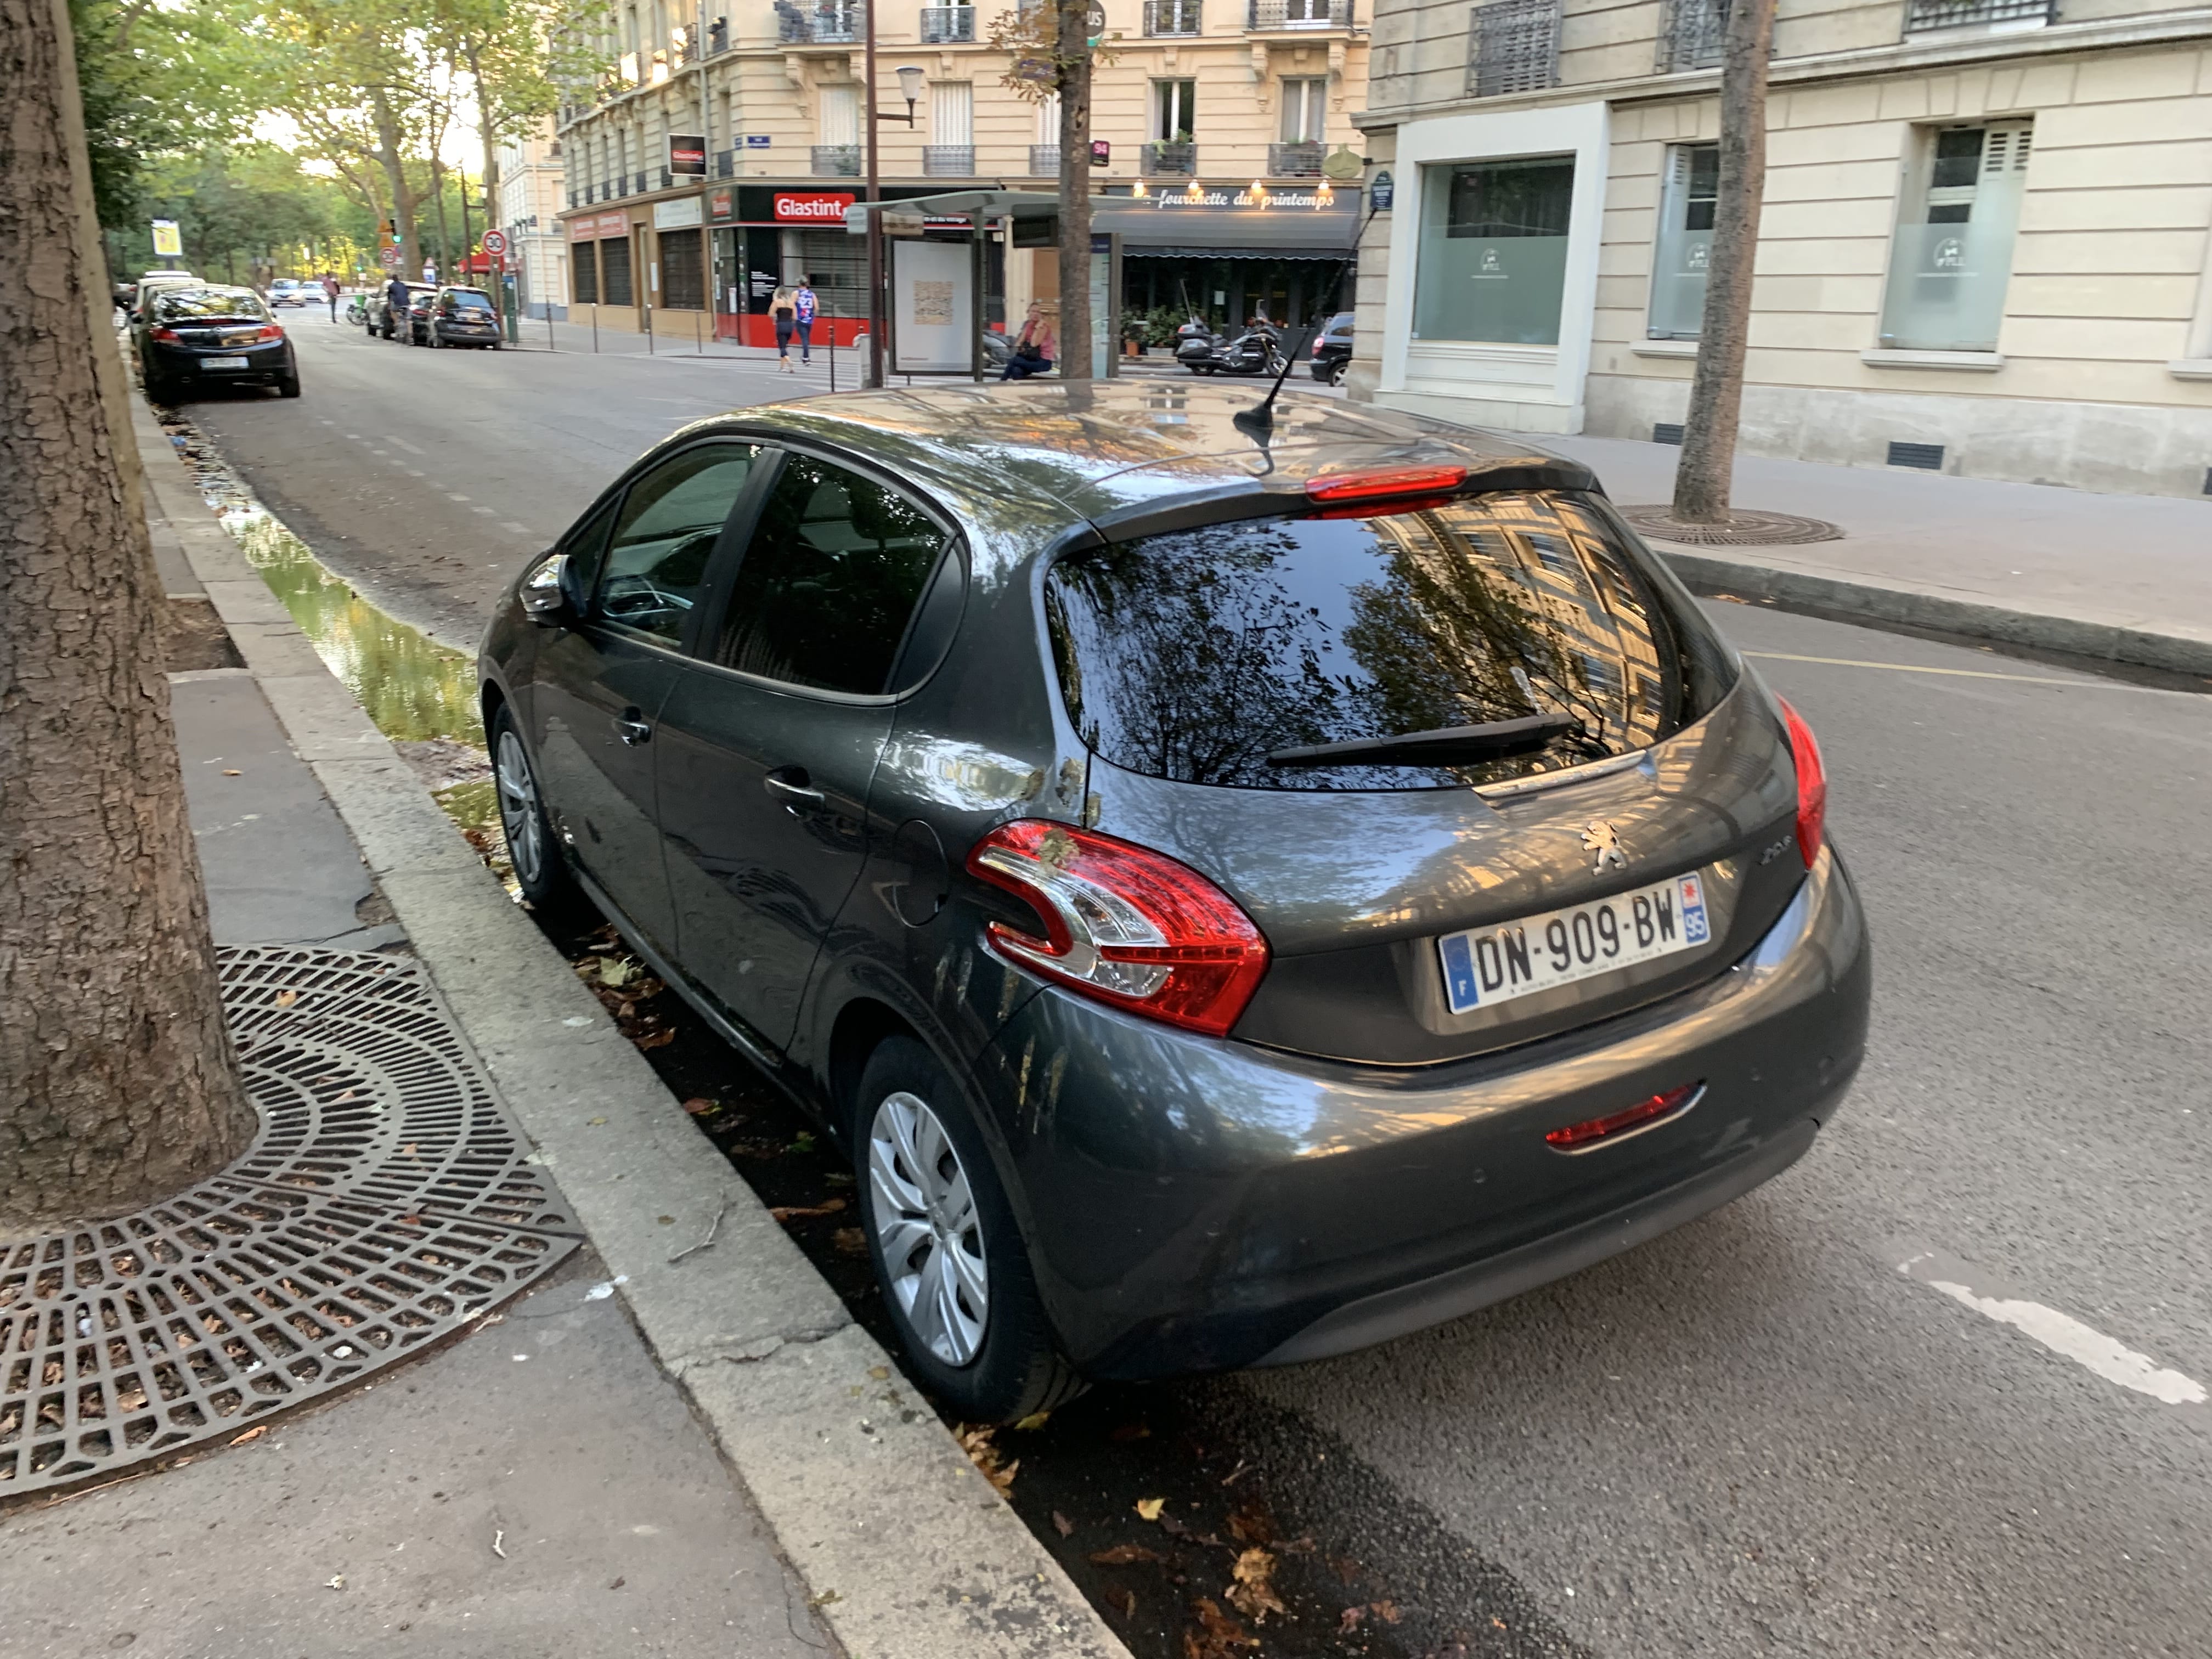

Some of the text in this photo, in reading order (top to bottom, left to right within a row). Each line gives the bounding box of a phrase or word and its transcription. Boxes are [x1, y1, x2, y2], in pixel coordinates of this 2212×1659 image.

[1094, 143, 1107, 155] 94
[777, 198, 842, 216] Glastint
[1158, 189, 1228, 208] fourchette
[1233, 190, 1254, 206] du
[1260, 192, 1335, 210] printemps
[487, 237, 501, 248] 30
[1686, 912, 1705, 938] 95
[1475, 888, 1676, 992] DN-909-BW
[1458, 979, 1466, 996] F
